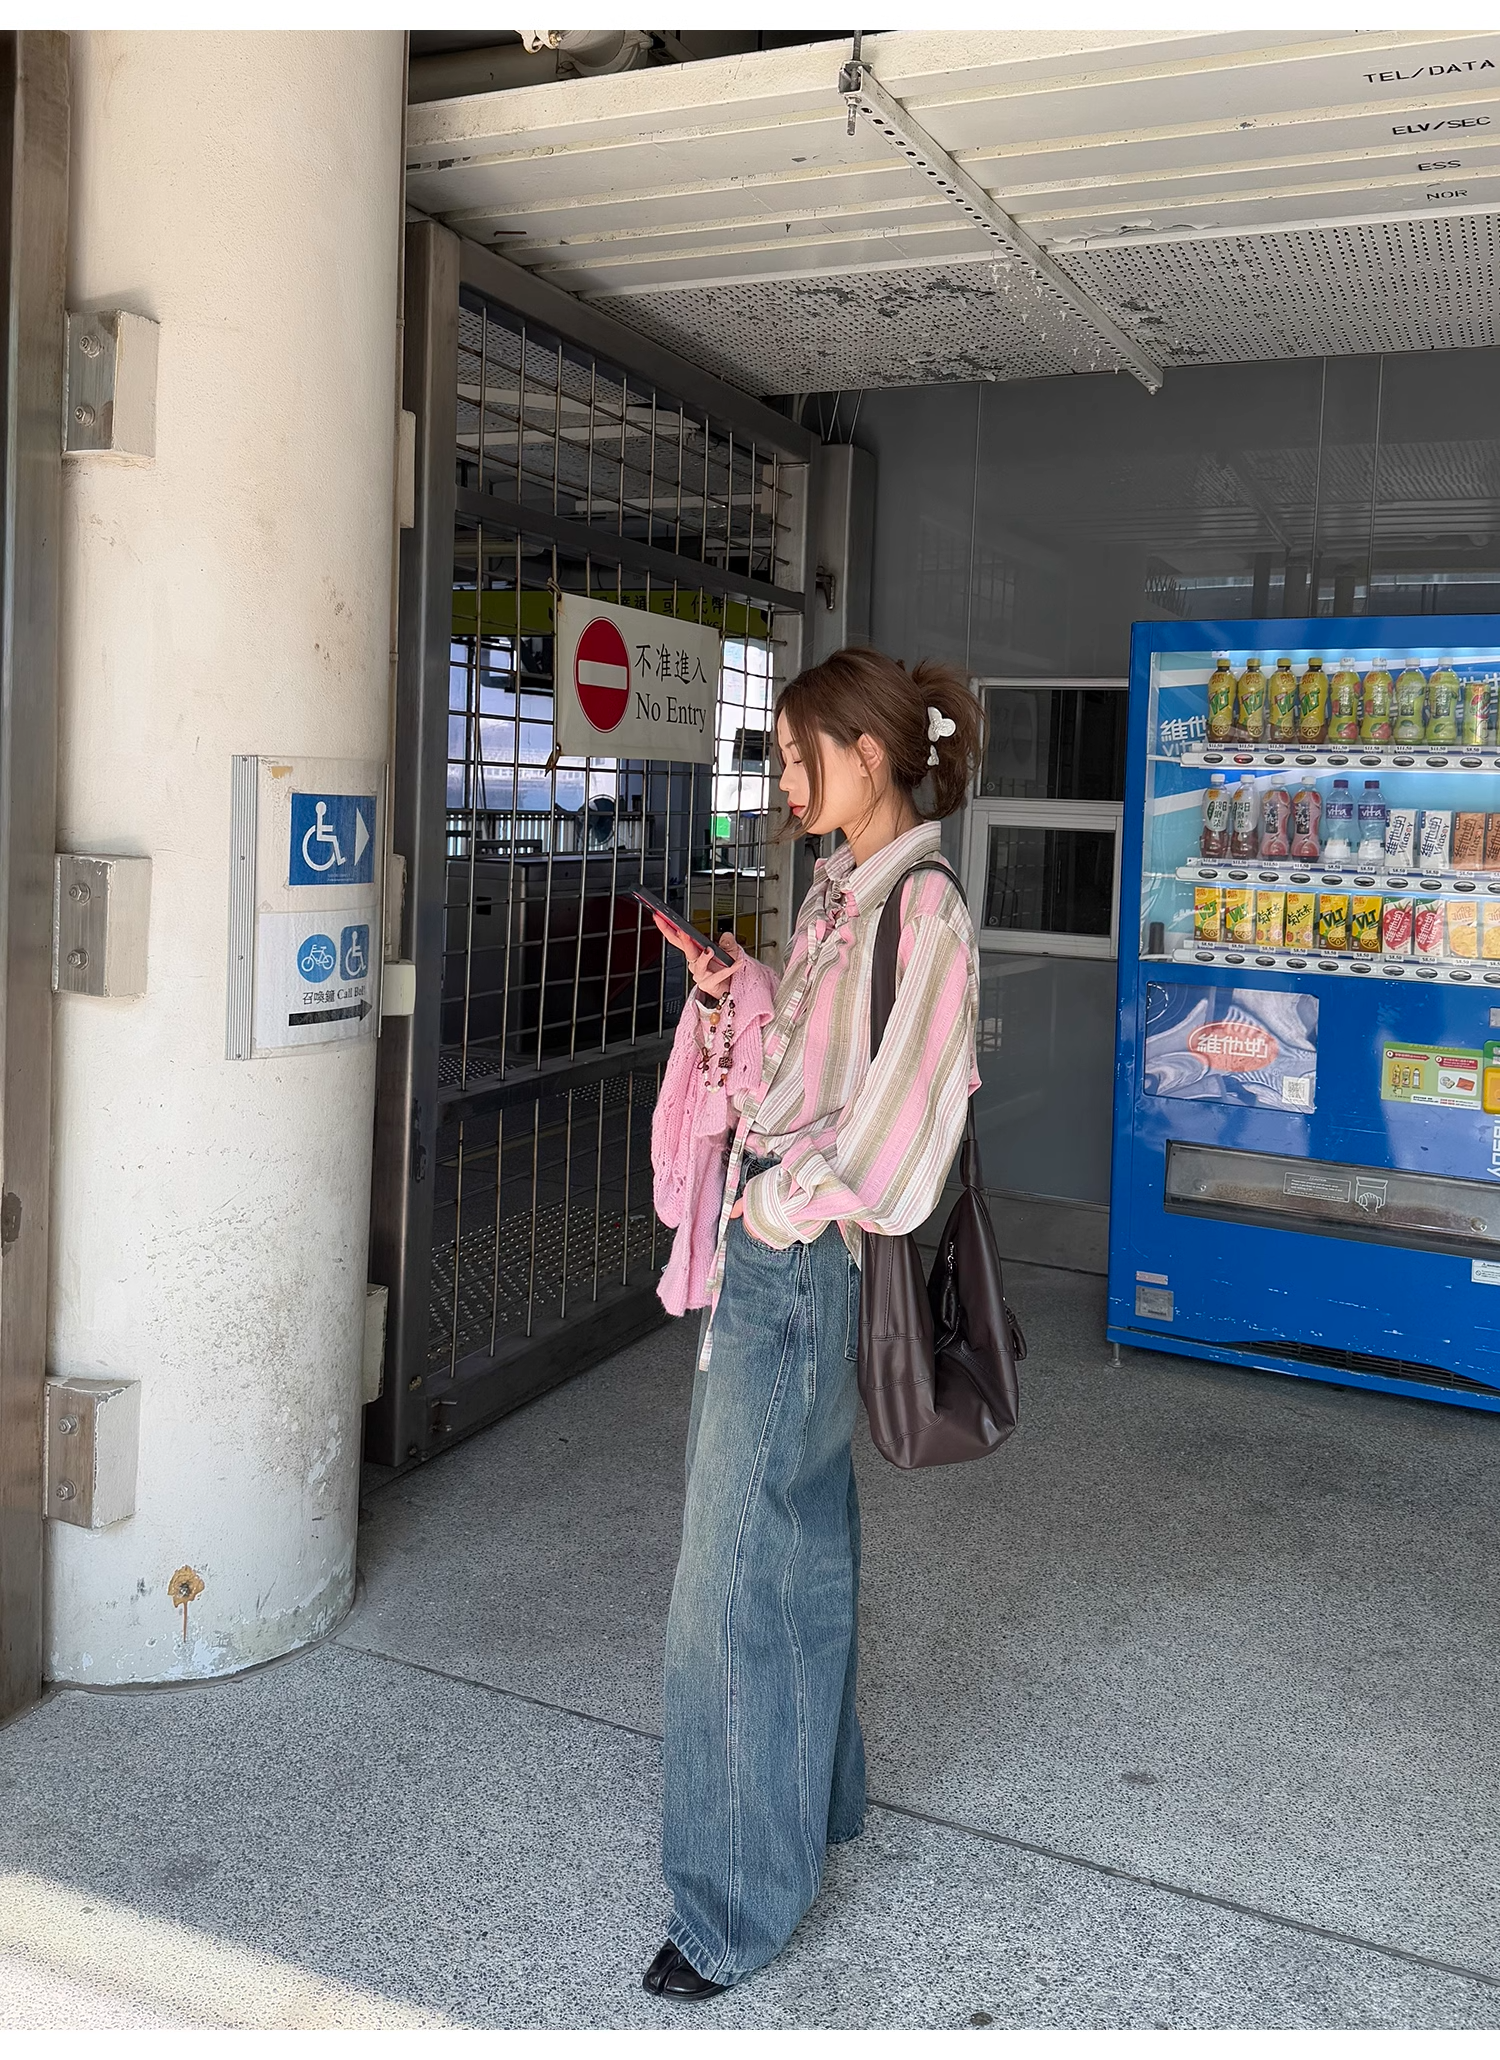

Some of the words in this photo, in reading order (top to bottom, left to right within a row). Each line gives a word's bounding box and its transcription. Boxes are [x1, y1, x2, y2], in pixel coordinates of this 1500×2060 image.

[1363, 59, 1496, 83] TEL/DATA
[1392, 116, 1491, 136] ELV/SEC
[1418, 160, 1462, 171] ESS
[1426, 189, 1468, 201] NOR
[634, 643, 708, 685] 不准進入
[635, 692, 661, 722] No
[666, 695, 707, 734] Entry
[1361, 805, 1382, 817] vita
[336, 987, 353, 1000] Call
[1197, 1034, 1268, 1058] 維他奶
